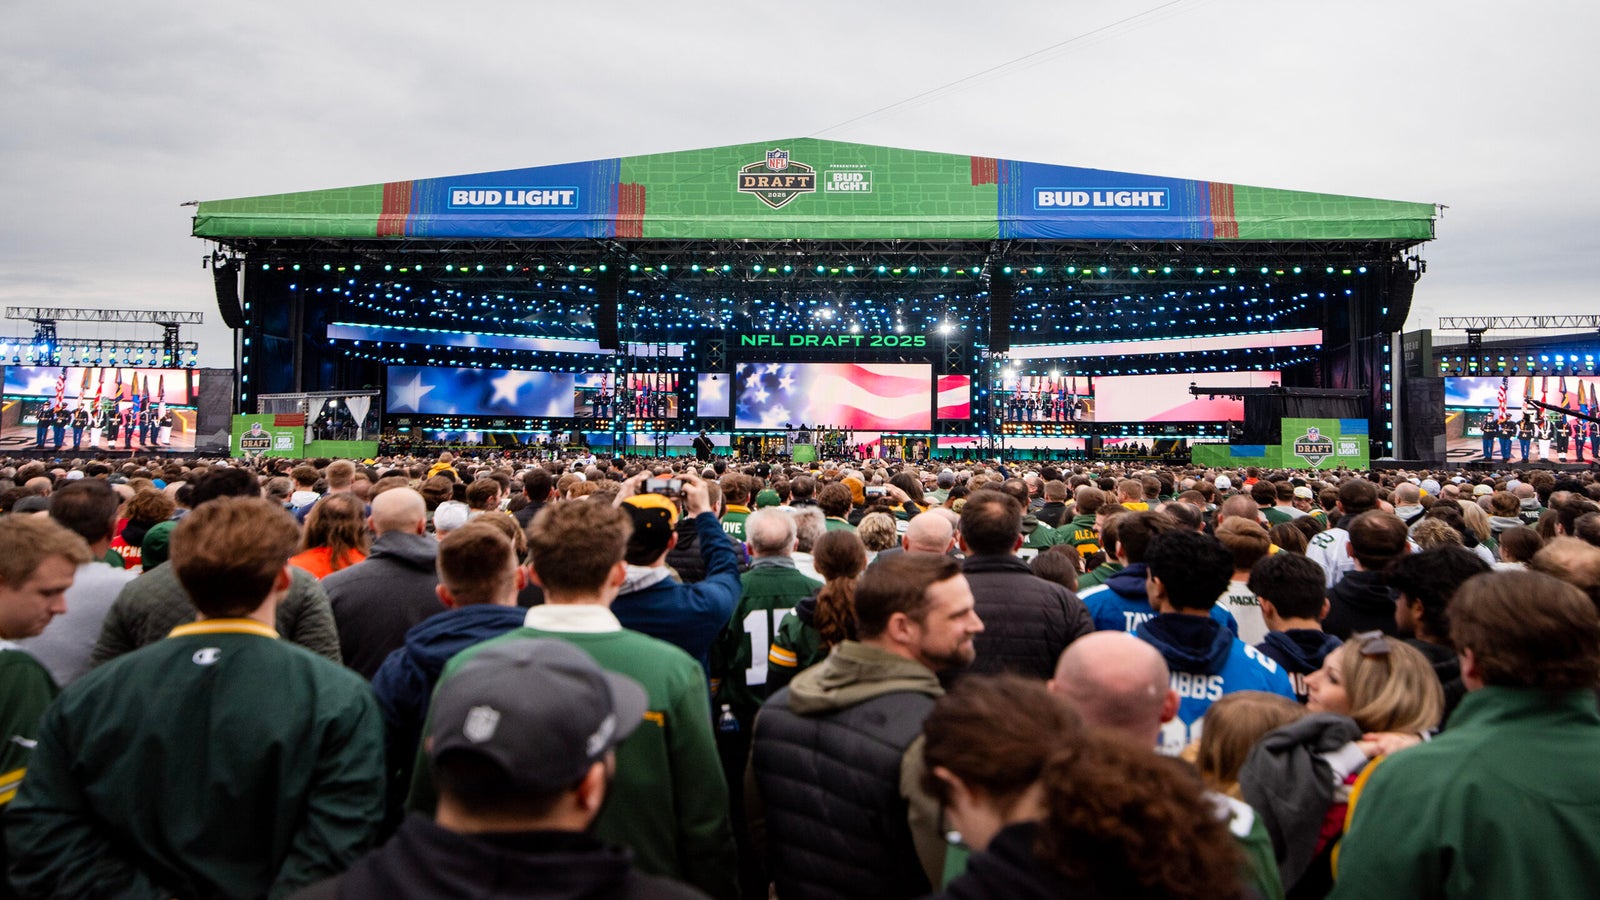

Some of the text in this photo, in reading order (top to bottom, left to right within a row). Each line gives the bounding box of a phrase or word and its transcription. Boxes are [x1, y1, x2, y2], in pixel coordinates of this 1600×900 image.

[769, 159, 786, 169] NFL
[744, 177, 810, 187] DRAFT
[833, 173, 864, 182] BUD
[827, 181, 869, 191] LIGHT
[452, 190, 574, 206] BUD LIGHT
[1038, 191, 1164, 207] BUD LIGHT
[741, 334, 926, 347] NFL DRAFT 2025
[723, 522, 742, 533] OVE
[1229, 595, 1260, 606] PACKE
[1171, 672, 1224, 701] IBBS
